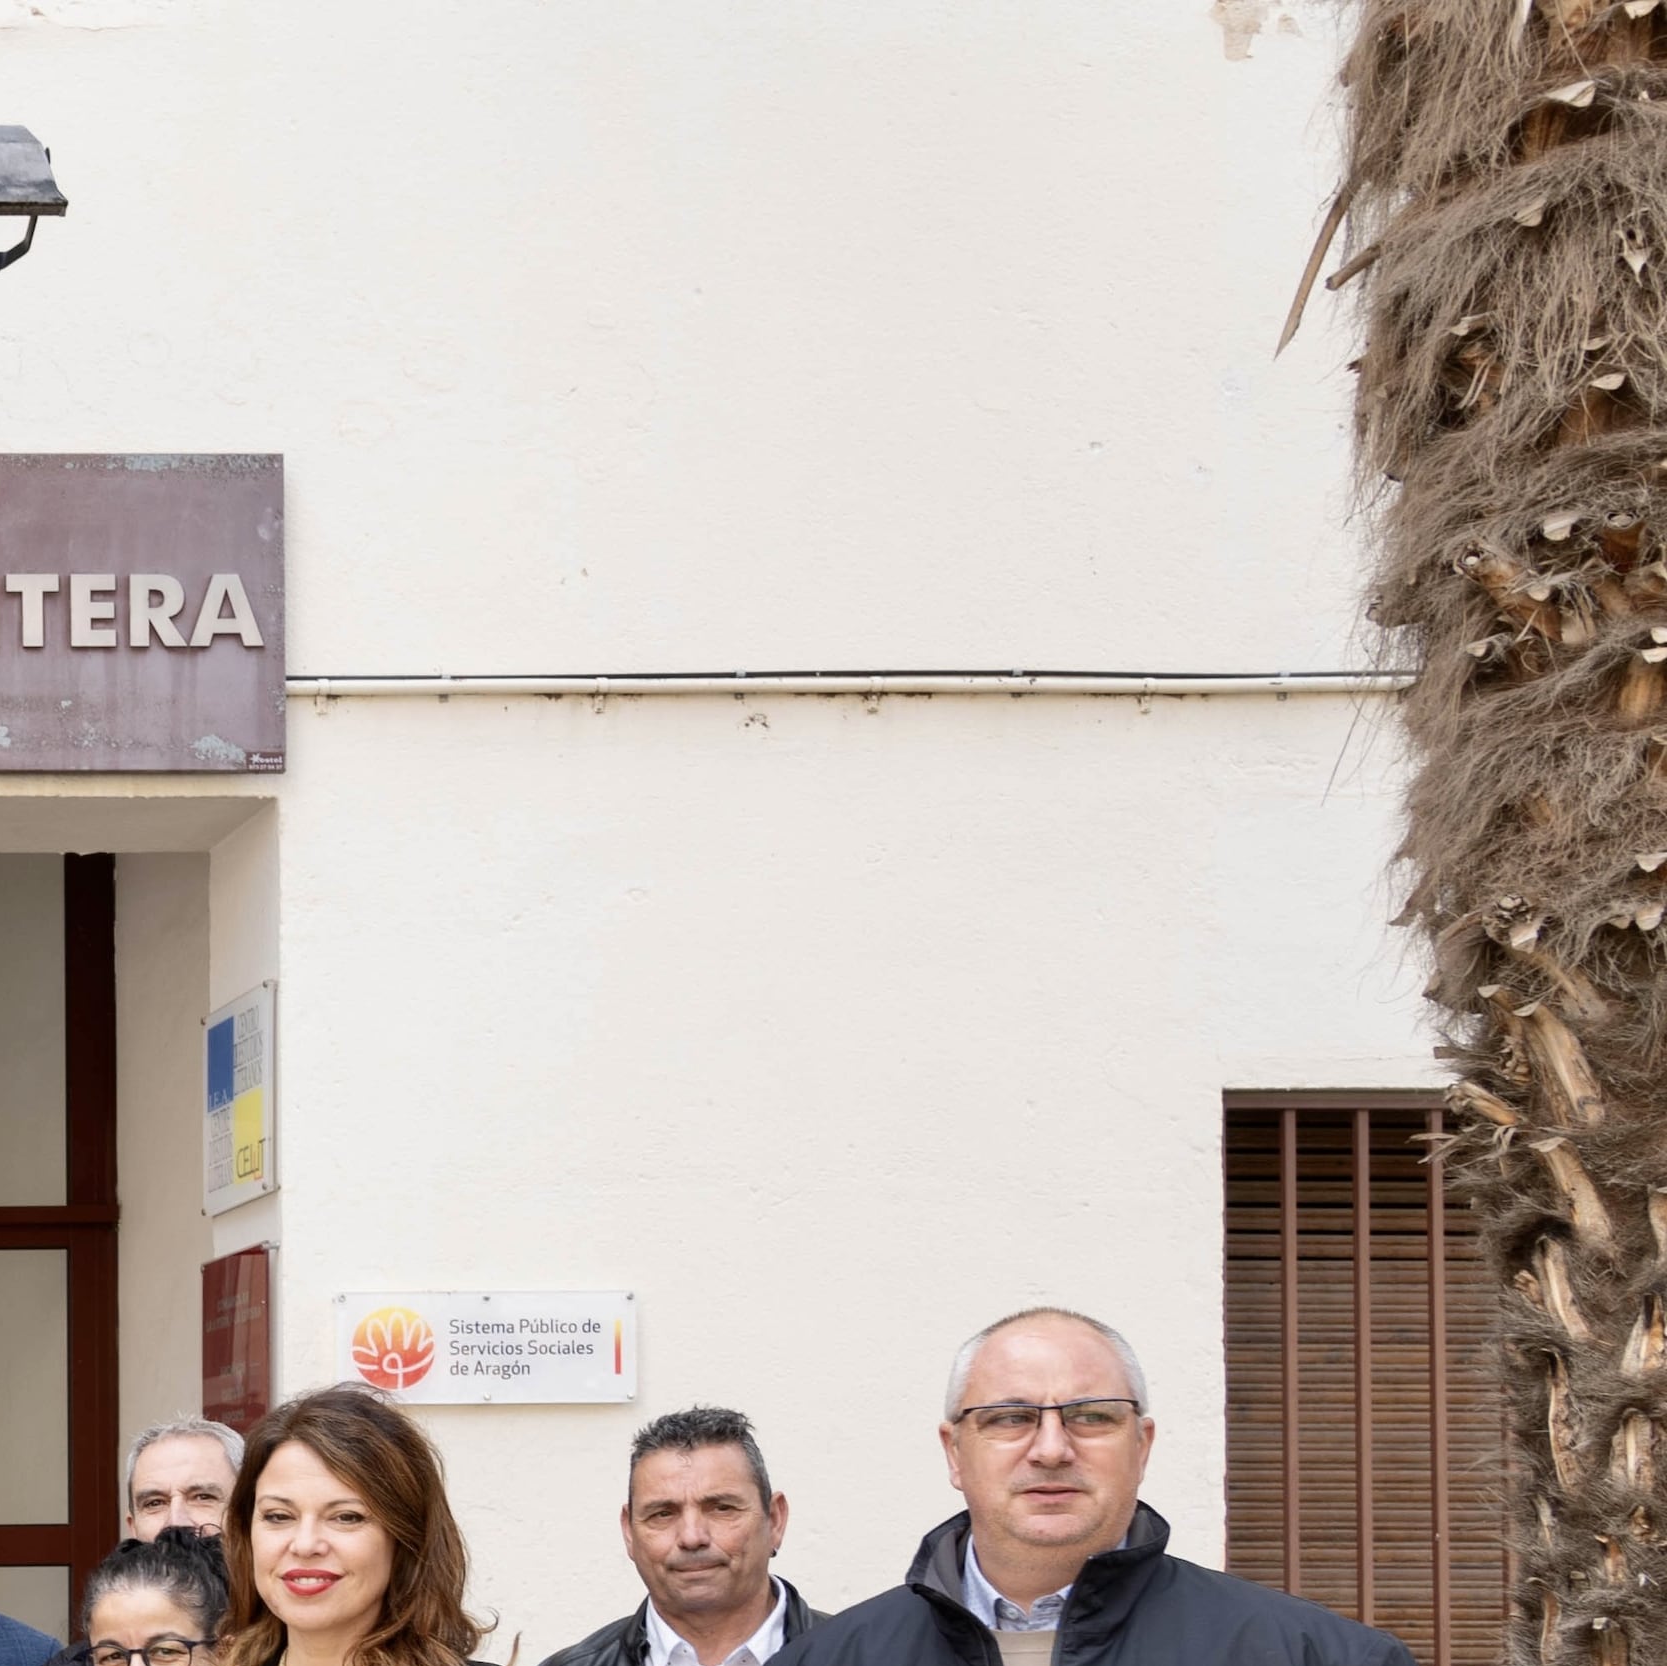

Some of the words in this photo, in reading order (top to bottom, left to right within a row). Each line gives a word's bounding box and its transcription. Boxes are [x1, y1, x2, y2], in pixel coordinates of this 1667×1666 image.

[449, 1319, 515, 1335] Sistema
[519, 1318, 578, 1334] Público
[581, 1318, 601, 1334] de
[449, 1340, 523, 1356] Servicios
[527, 1339, 594, 1356] Sociales
[449, 1361, 469, 1376] de
[473, 1360, 531, 1380] Aragón
